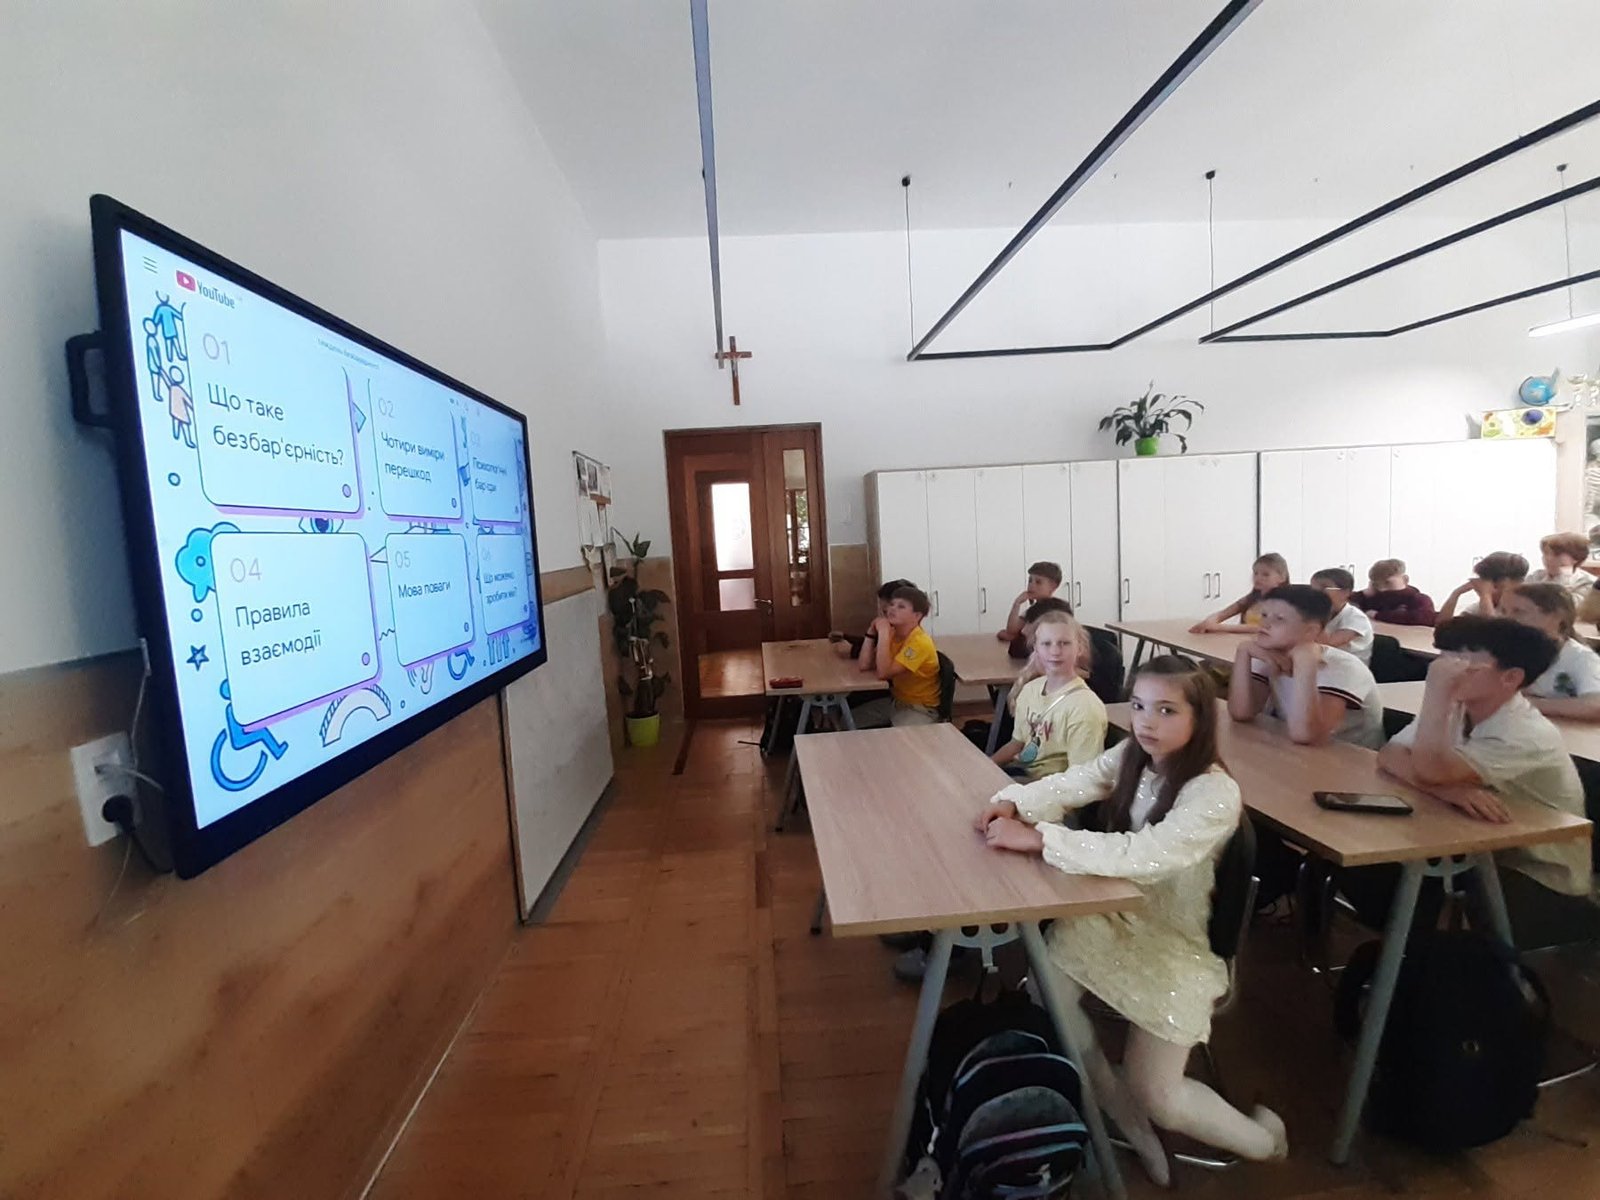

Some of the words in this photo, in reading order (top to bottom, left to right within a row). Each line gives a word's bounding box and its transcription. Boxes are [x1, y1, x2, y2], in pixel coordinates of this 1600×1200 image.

[197, 279, 235, 309] YouTube
[203, 333, 231, 365] 01
[207, 383, 241, 412] Що
[246, 398, 285, 421] таке
[378, 396, 396, 419] 02
[212, 425, 344, 466] безбар'єрність?
[381, 431, 417, 455] Чотири
[384, 462, 432, 483] перешкод
[230, 557, 263, 583] 04
[394, 550, 412, 569] 05
[397, 583, 423, 599] Мова
[424, 580, 451, 594] поваги
[235, 601, 312, 631] Правила
[241, 629, 322, 666] взаємодії
